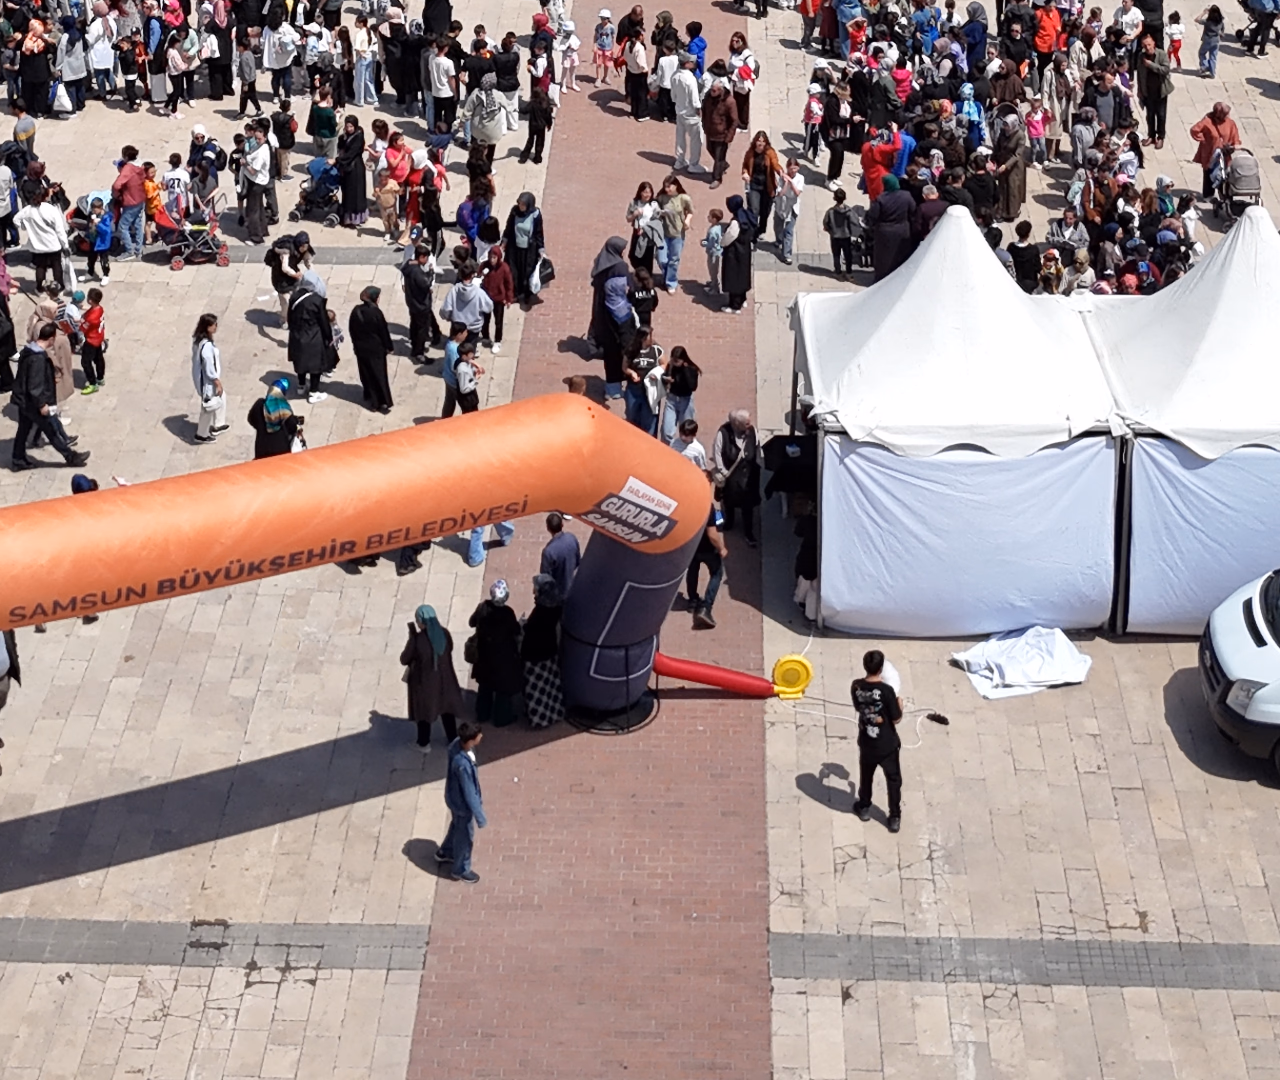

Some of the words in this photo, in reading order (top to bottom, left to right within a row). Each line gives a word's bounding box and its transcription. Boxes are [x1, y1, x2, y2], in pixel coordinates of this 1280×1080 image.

[169, 177, 181, 189] 27
[600, 496, 669, 537] GURURLA
[9, 582, 147, 624] SAMSUN
[157, 538, 357, 596] BÜYÜKŞEHİR
[365, 493, 530, 551] BELEDİYESİ
